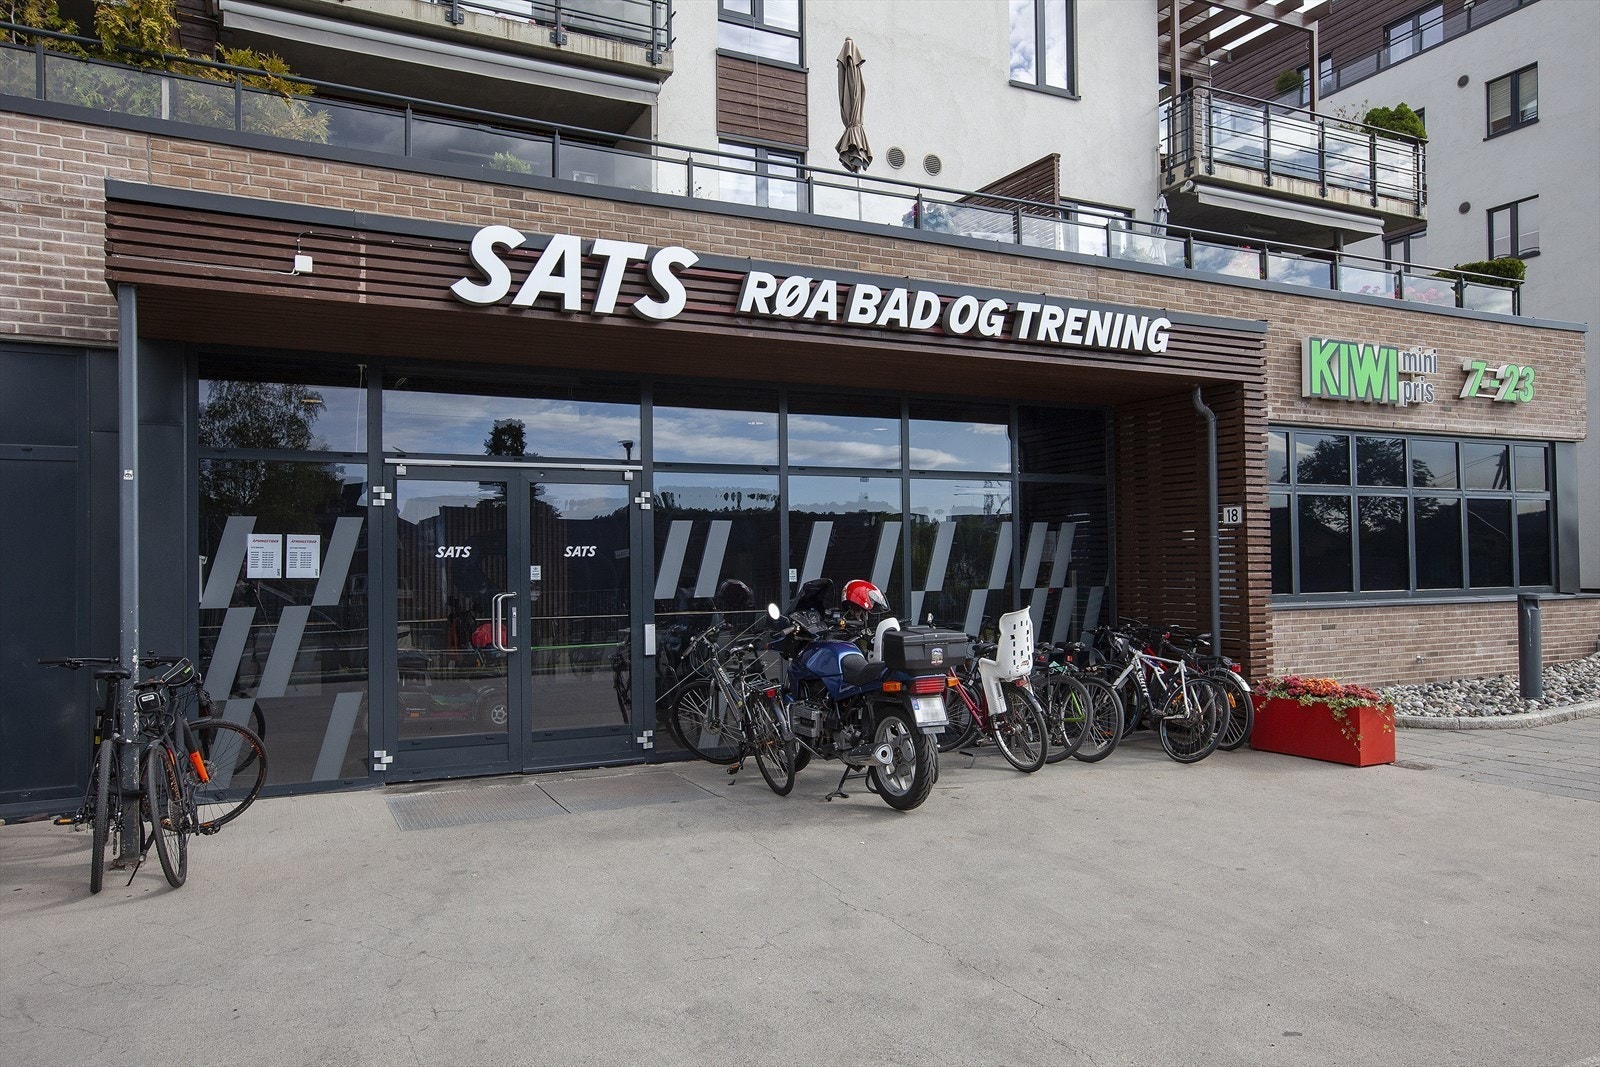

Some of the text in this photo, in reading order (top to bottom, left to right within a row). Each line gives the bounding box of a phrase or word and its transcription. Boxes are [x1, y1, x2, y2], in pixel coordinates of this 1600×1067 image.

[450, 225, 1172, 353] SATS RØA BAD OG TRENING
[1307, 336, 1399, 404] KIWI
[1402, 346, 1438, 374] mini
[1402, 375, 1435, 407] pris
[1226, 508, 1239, 522] 18
[435, 546, 472, 558] SATS
[563, 545, 597, 558] SATS
